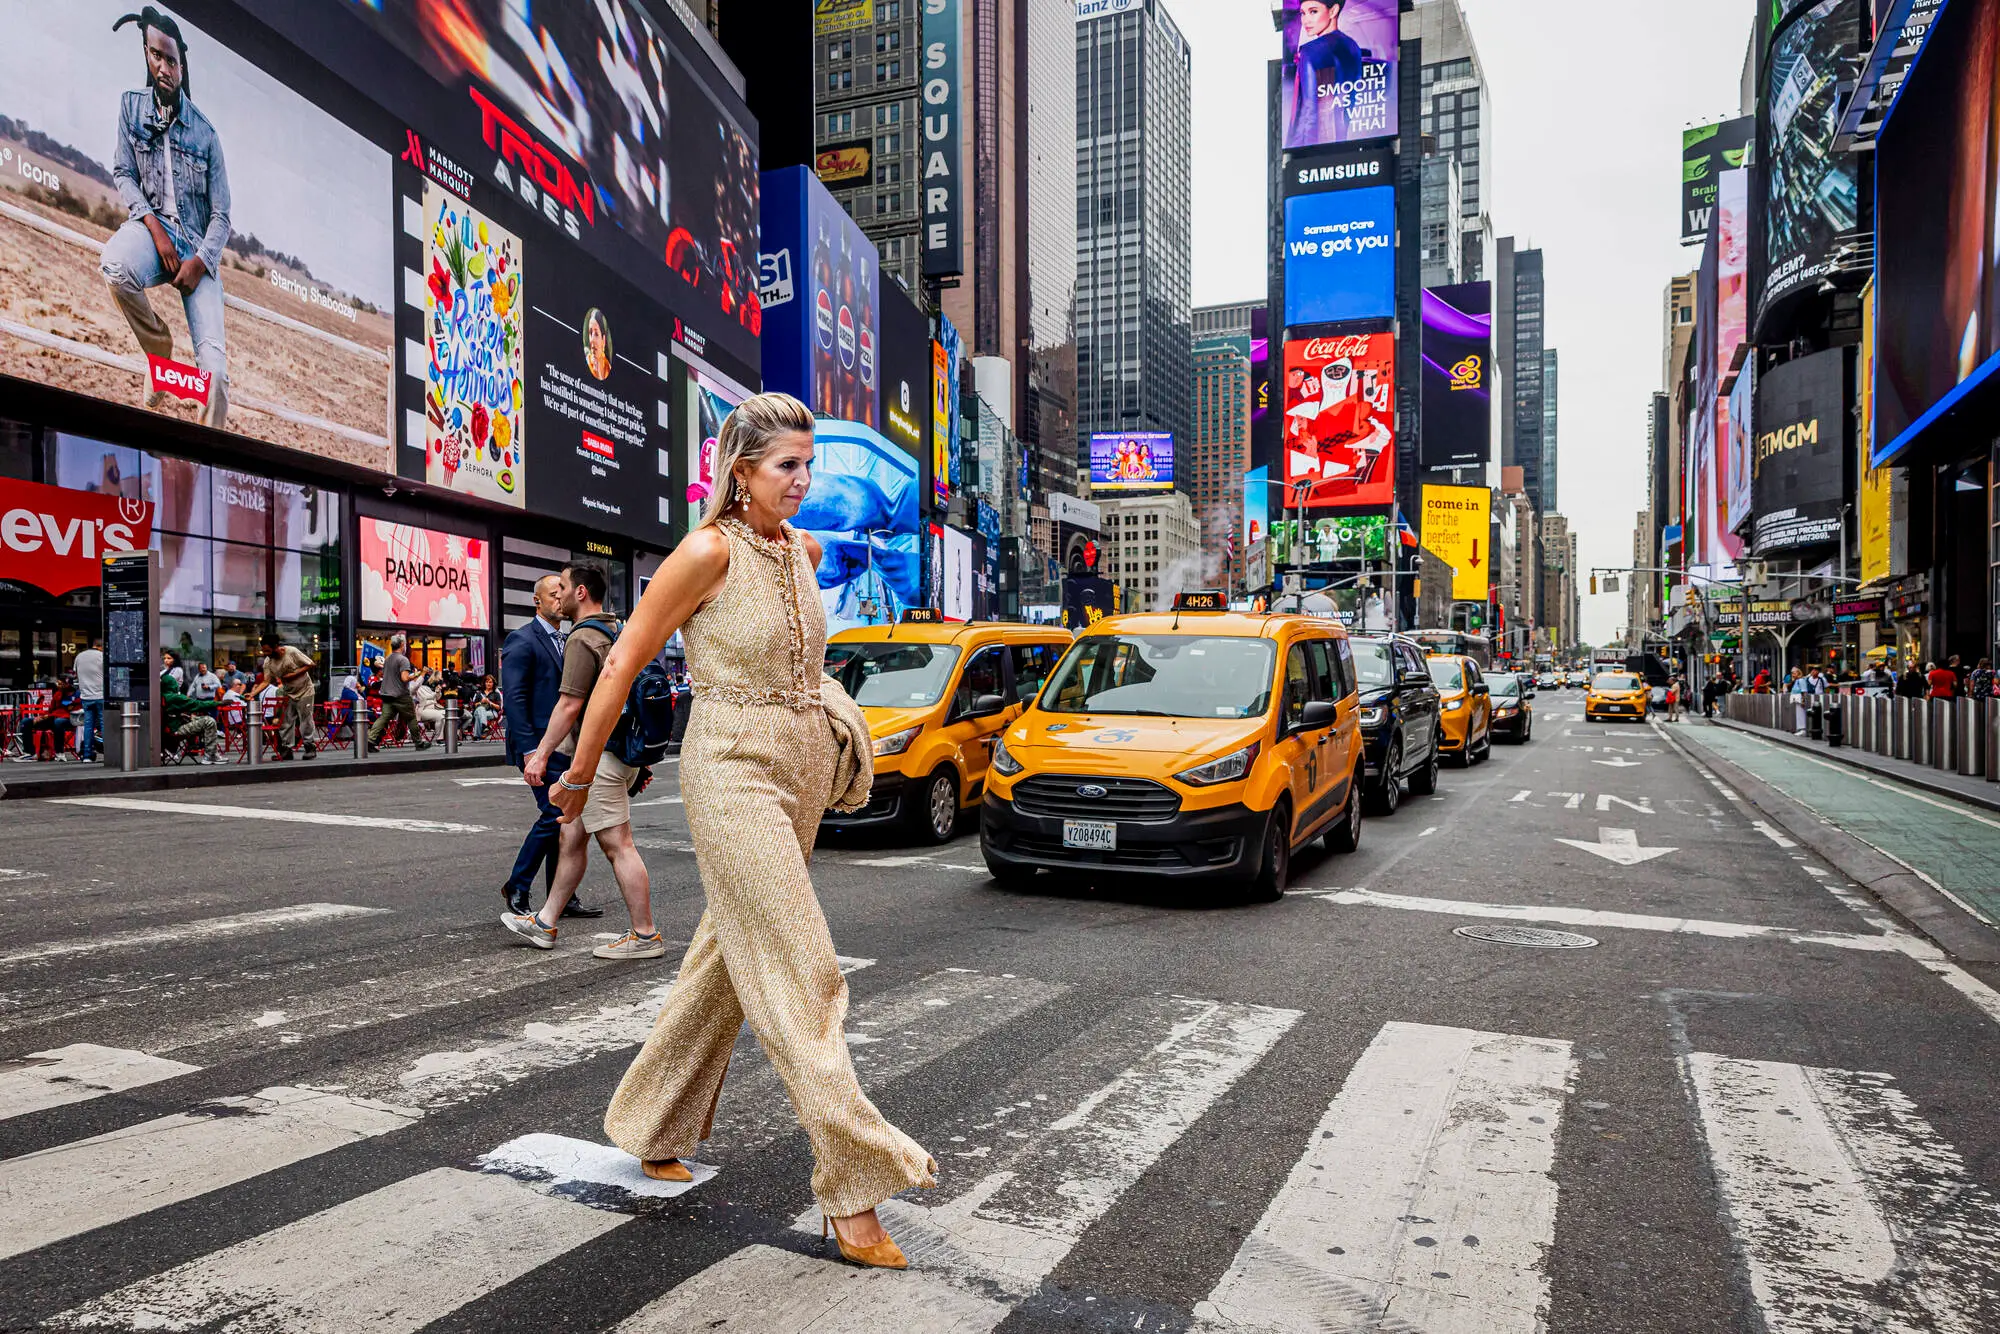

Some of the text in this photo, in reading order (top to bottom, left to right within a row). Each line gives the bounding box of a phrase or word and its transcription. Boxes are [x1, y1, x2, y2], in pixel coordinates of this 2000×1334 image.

[1363, 63, 1388, 79] FLY
[1317, 77, 1386, 98] SMOOTH
[1331, 89, 1387, 110] AS SILK
[1346, 103, 1386, 120] WITH
[1350, 117, 1386, 133] THAI
[469, 85, 594, 228] TRON
[924, 42, 950, 250] SQUARE
[17, 153, 60, 191] Icons
[429, 146, 475, 186] MARRIOTT
[1298, 161, 1380, 184] SAMSUNG
[429, 162, 470, 199] MARQUIS
[494, 158, 581, 240] ARES
[1304, 219, 1375, 236] Samsung Care
[1290, 234, 1389, 258] We got you
[271, 269, 357, 323] Starring Shaboozey
[684, 325, 706, 346] MARRIOTT
[464, 342, 494, 373] son
[1303, 334, 1371, 360] Coca-Cola
[540, 375, 551, 391] has
[551, 380, 573, 403] instilled
[573, 391, 579, 404] is
[579, 397, 604, 418] something
[607, 409, 618, 422] take
[618, 414, 629, 428] great
[629, 419, 641, 433] pride
[560, 369, 575, 387] sense
[574, 377, 581, 390] of
[580, 382, 608, 405] community
[608, 393, 618, 408] that
[625, 401, 643, 420] heritage
[560, 402, 568, 416] all
[568, 406, 580, 420] part
[579, 411, 586, 423] of
[585, 415, 611, 436] something
[610, 423, 625, 440] bigger
[1755, 419, 1818, 475] ETMGM
[464, 463, 493, 479] SEPHORA
[1427, 498, 1480, 511] come in
[1426, 510, 1459, 526] for the
[1798, 522, 1841, 535] PROBLEM?
[0, 508, 135, 560] evi's
[1426, 529, 1461, 546] perfect
[586, 541, 613, 556] SEPHORA
[1430, 546, 1449, 560] ifts
[385, 557, 470, 592] PANDORA
[1186, 595, 1214, 608] 4H26
[911, 610, 931, 620] 7D18
[1751, 611, 1793, 623] LUGGAGE
[1068, 827, 1111, 844] Y208494C
